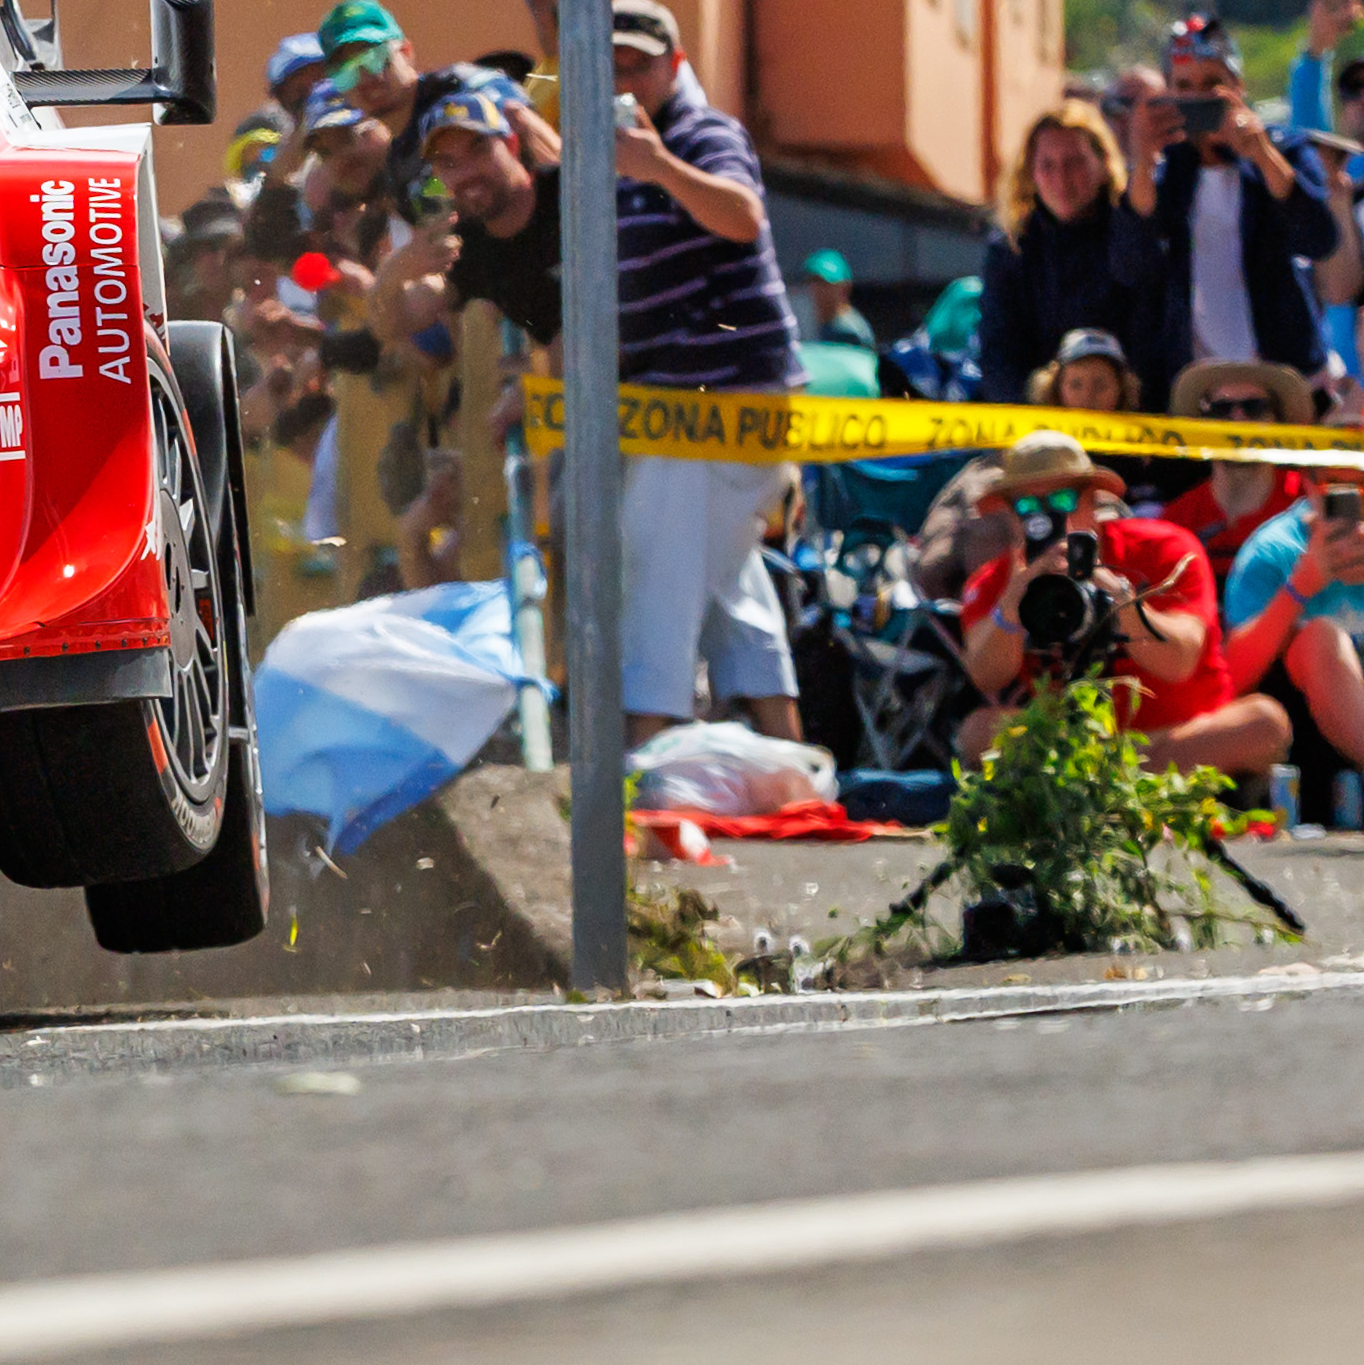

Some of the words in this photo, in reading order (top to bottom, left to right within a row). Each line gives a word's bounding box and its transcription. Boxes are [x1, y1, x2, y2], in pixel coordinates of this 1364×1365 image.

[29, 179, 84, 380] Panasonic
[88, 177, 132, 385] AUTOMOTIVE
[619, 396, 726, 444] ZONA
